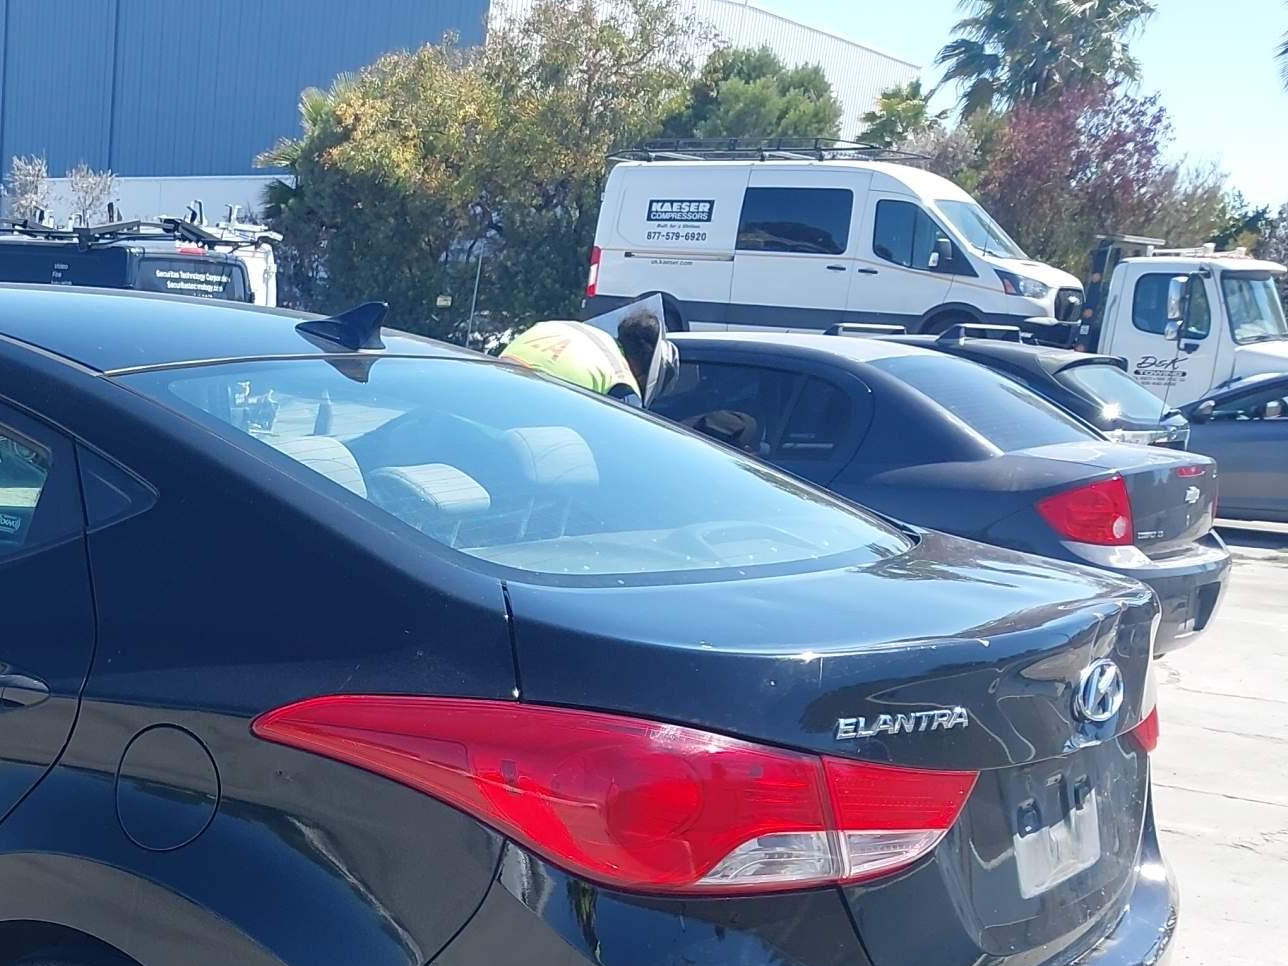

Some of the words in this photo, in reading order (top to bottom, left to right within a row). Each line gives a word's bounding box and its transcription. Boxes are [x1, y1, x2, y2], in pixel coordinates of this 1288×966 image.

[651, 202, 711, 212] KAESER
[650, 212, 708, 220] COMPRESSORS
[646, 231, 707, 241] 877-579-6920
[1136, 355, 1189, 370] D&K
[835, 706, 969, 740] ELANTRA
